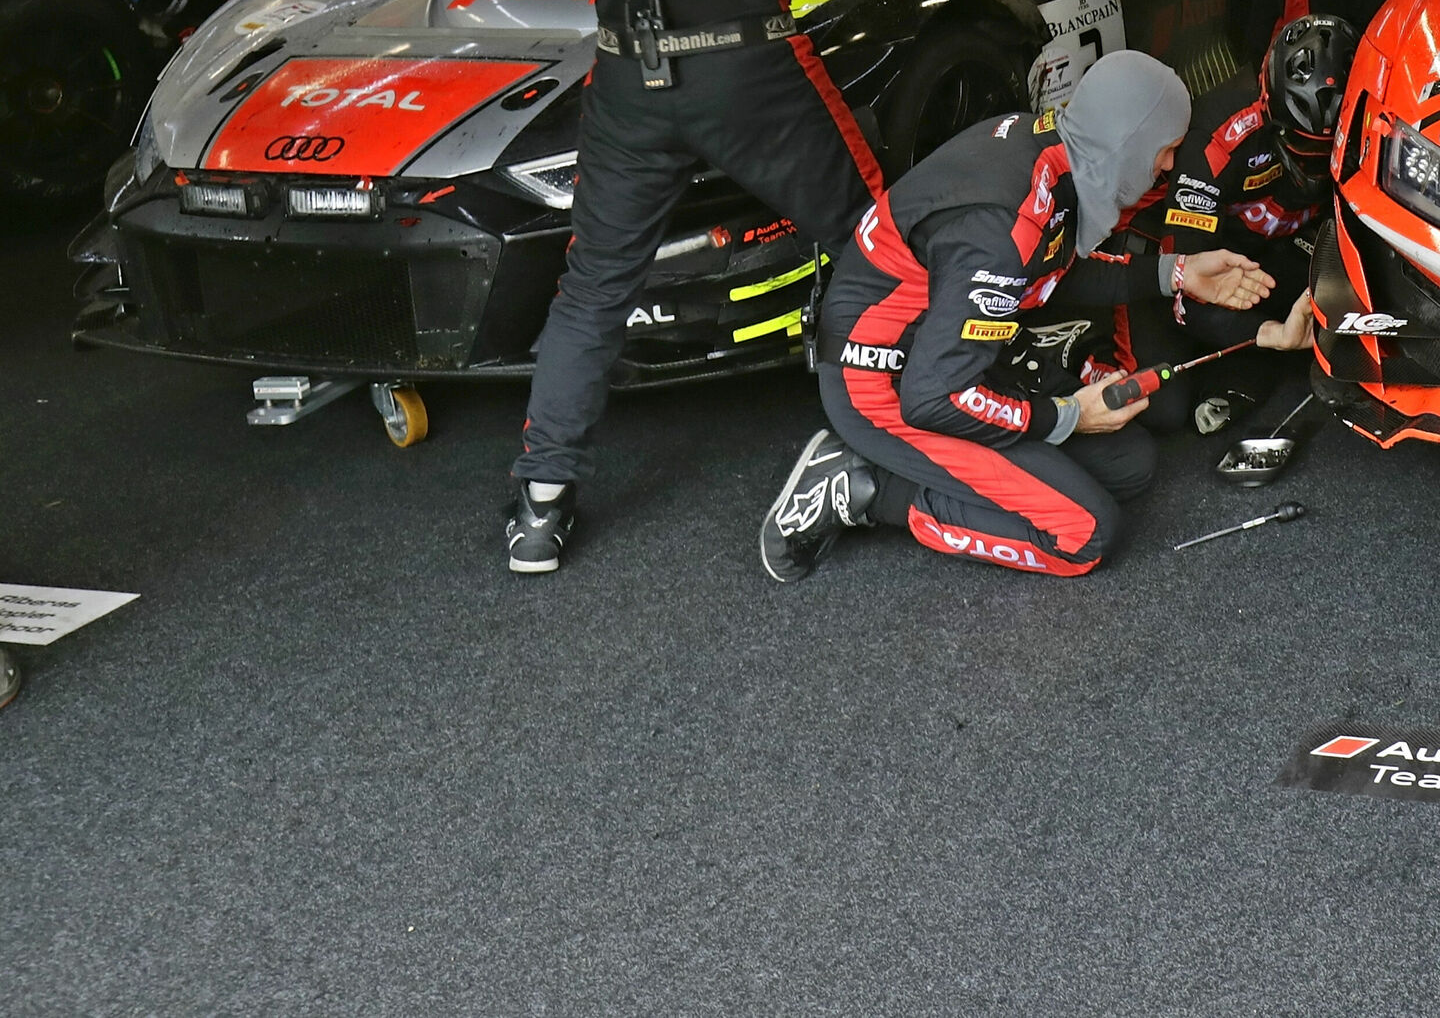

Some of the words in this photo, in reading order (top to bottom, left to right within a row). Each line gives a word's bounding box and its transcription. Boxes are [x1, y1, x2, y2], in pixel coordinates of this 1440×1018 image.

[280, 83, 426, 112] TOTAL
[1177, 173, 1221, 197] Snap-on
[755, 220, 780, 237] Audi
[1169, 211, 1214, 230] PIRELLI
[757, 230, 785, 246] Team
[971, 293, 1020, 311] GrafiWrap
[967, 322, 1012, 337] PIRELLI
[958, 385, 1024, 428] TOTAL
